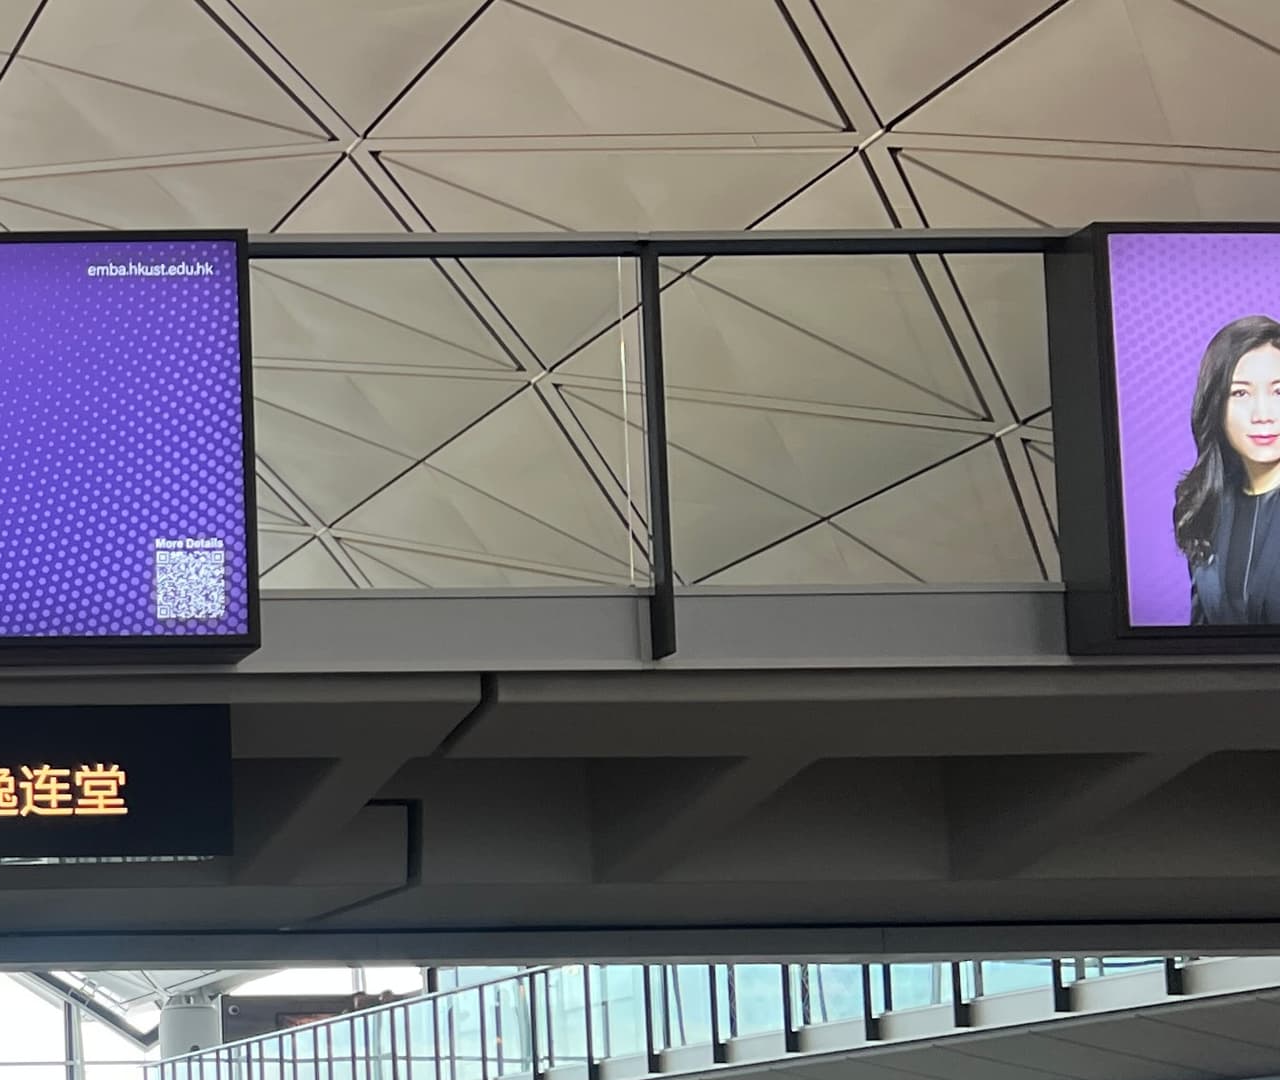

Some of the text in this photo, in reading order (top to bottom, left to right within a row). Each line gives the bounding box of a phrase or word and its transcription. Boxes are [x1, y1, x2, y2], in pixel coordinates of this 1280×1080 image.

[87, 261, 214, 277] emba.hkust.edu.hk
[155, 537, 224, 549] More Details
